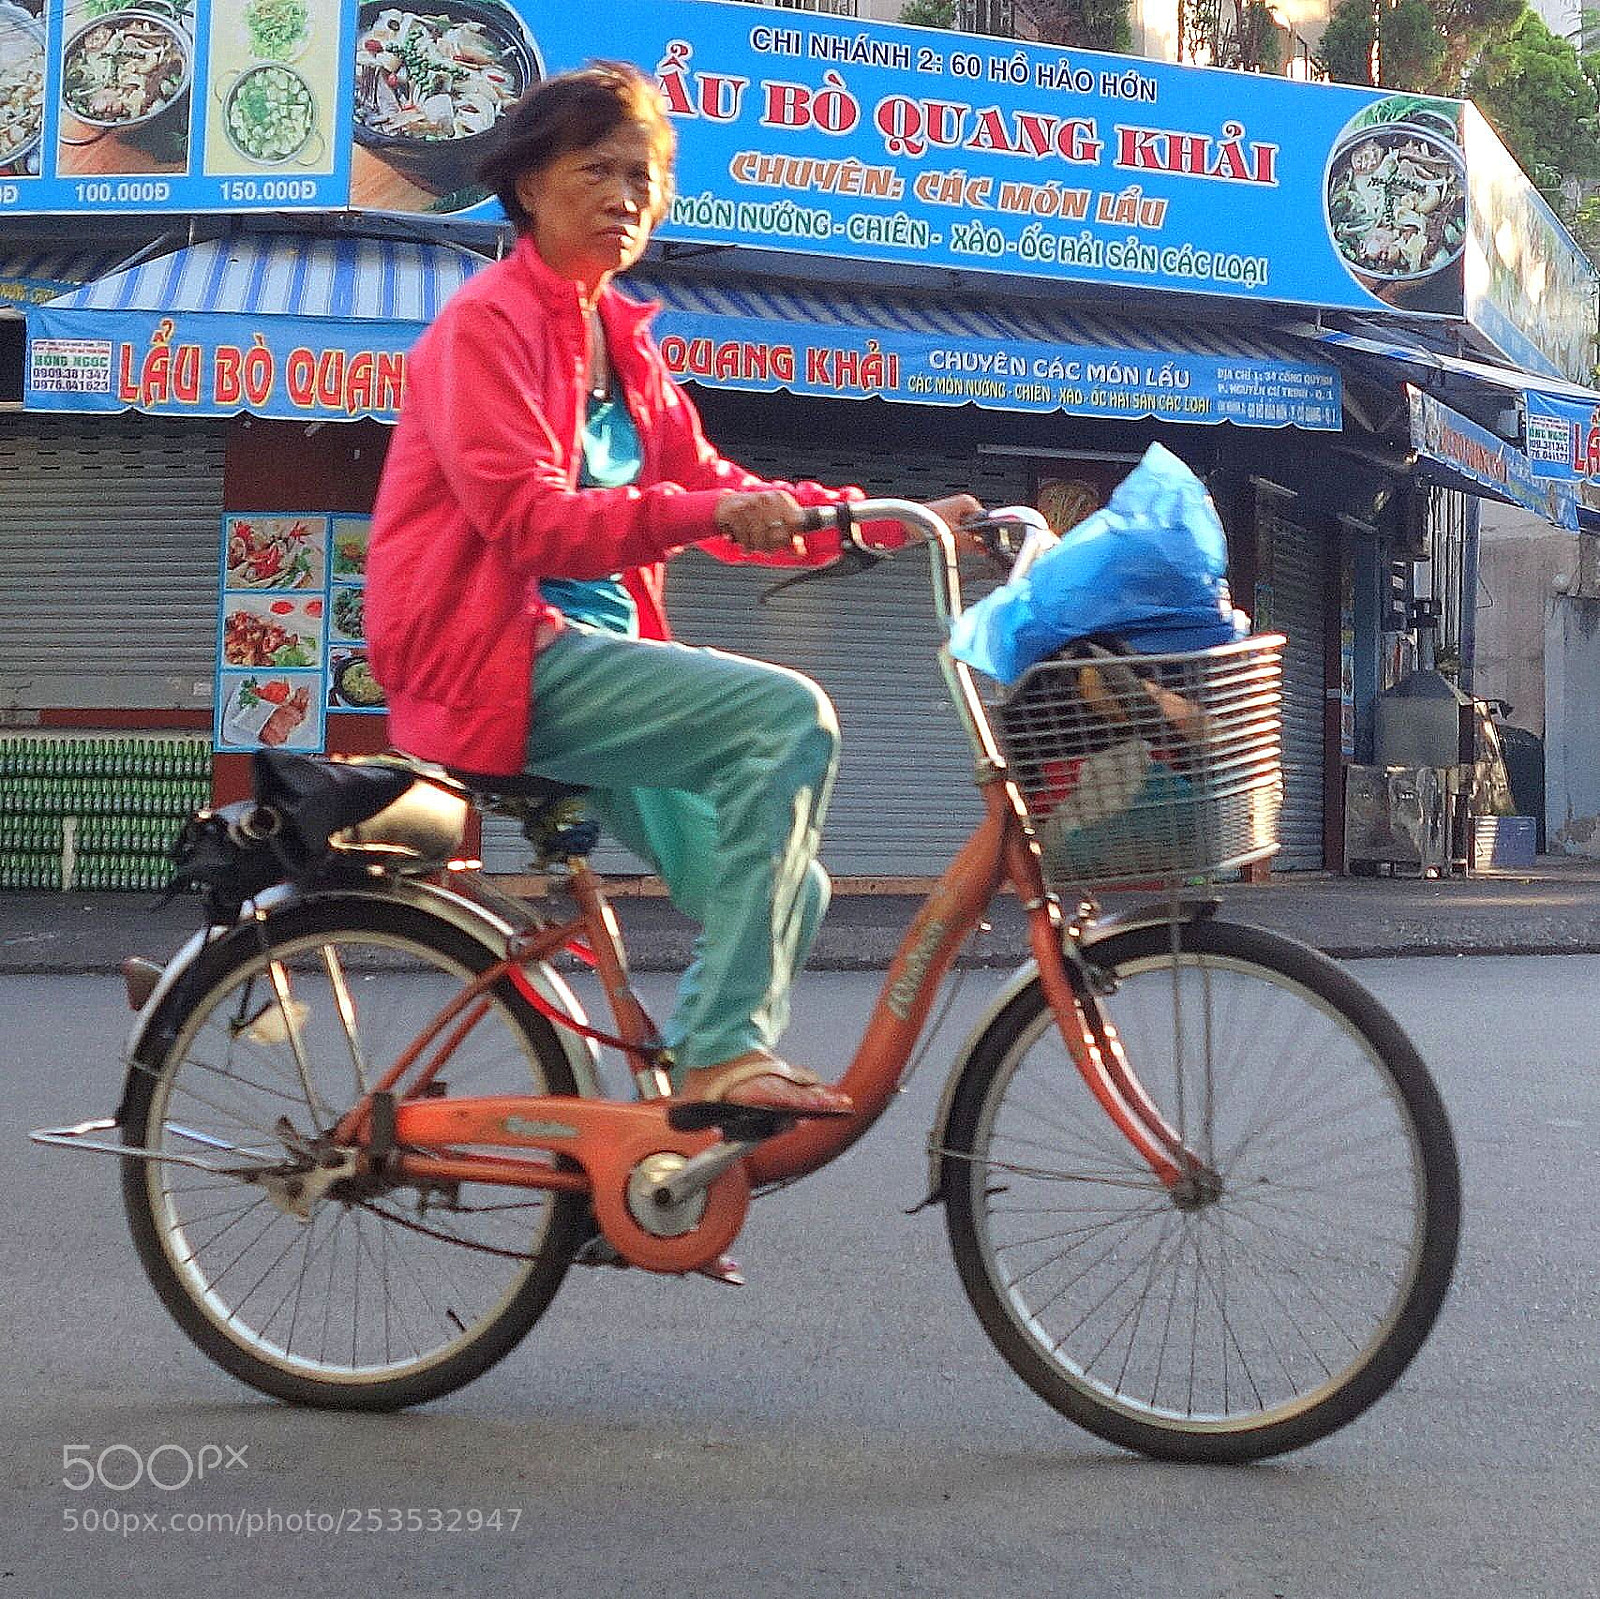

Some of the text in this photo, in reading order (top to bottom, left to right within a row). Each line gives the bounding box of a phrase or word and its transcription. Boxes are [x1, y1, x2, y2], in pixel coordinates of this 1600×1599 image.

[752, 28, 1158, 101] CHI NHÁNH 2: 60 HỒ HẢO HỚN
[658, 41, 1276, 184] ẨU BÒ QUANG KHẢI
[75, 182, 170, 202] 100.000Đ
[219, 180, 317, 200] 150.000Đ
[731, 153, 1169, 228] CHUYÊN: CÁC MÓN LẨU
[673, 194, 734, 226] MÓN
[740, 200, 830, 237] NƯỚNG
[849, 214, 928, 246] CHIÊN
[952, 221, 1002, 253] XÀO
[1021, 223, 1055, 259] ỐC
[1059, 232, 1102, 265] HẢI
[1108, 237, 1157, 272] SẢN
[1163, 244, 1213, 277] CÁC
[1214, 254, 1269, 289] LOẠI
[119, 318, 405, 416] LẨU BÒ QUAN
[661, 335, 901, 391] QUANG KHẢI
[928, 349, 1027, 377] CHUYÊN
[1033, 356, 1081, 382] CÁC
[1087, 360, 1140, 385] MÓN
